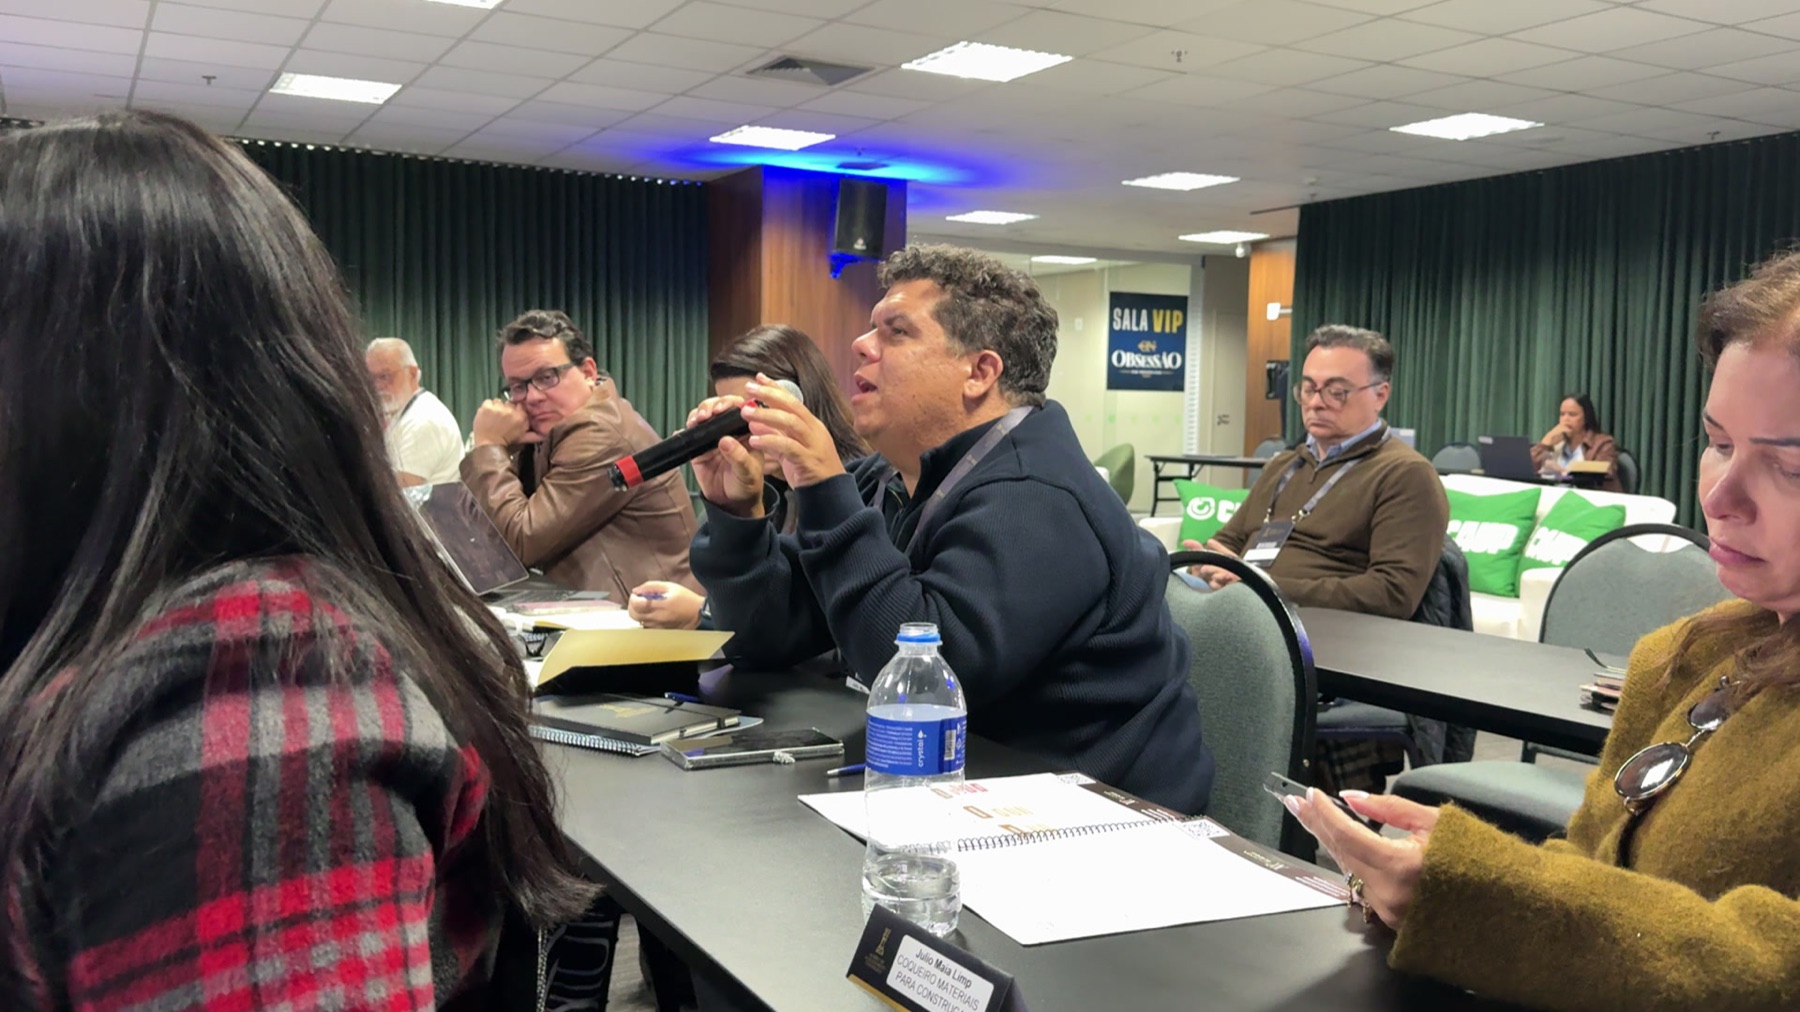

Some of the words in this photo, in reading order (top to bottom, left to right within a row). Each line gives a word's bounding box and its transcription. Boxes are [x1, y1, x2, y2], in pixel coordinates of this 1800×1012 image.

[1113, 307, 1148, 331] SALA
[1152, 309, 1183, 334] VIP
[1111, 350, 1182, 369] OBSESSÃO
[917, 739, 925, 767] crystal
[915, 948, 933, 966] Julio
[934, 958, 952, 976] Maia
[952, 969, 972, 989] Limp
[896, 954, 937, 985] COQUEIRO
[937, 978, 980, 1011] MATERIAIS
[896, 973, 916, 993] PARA
